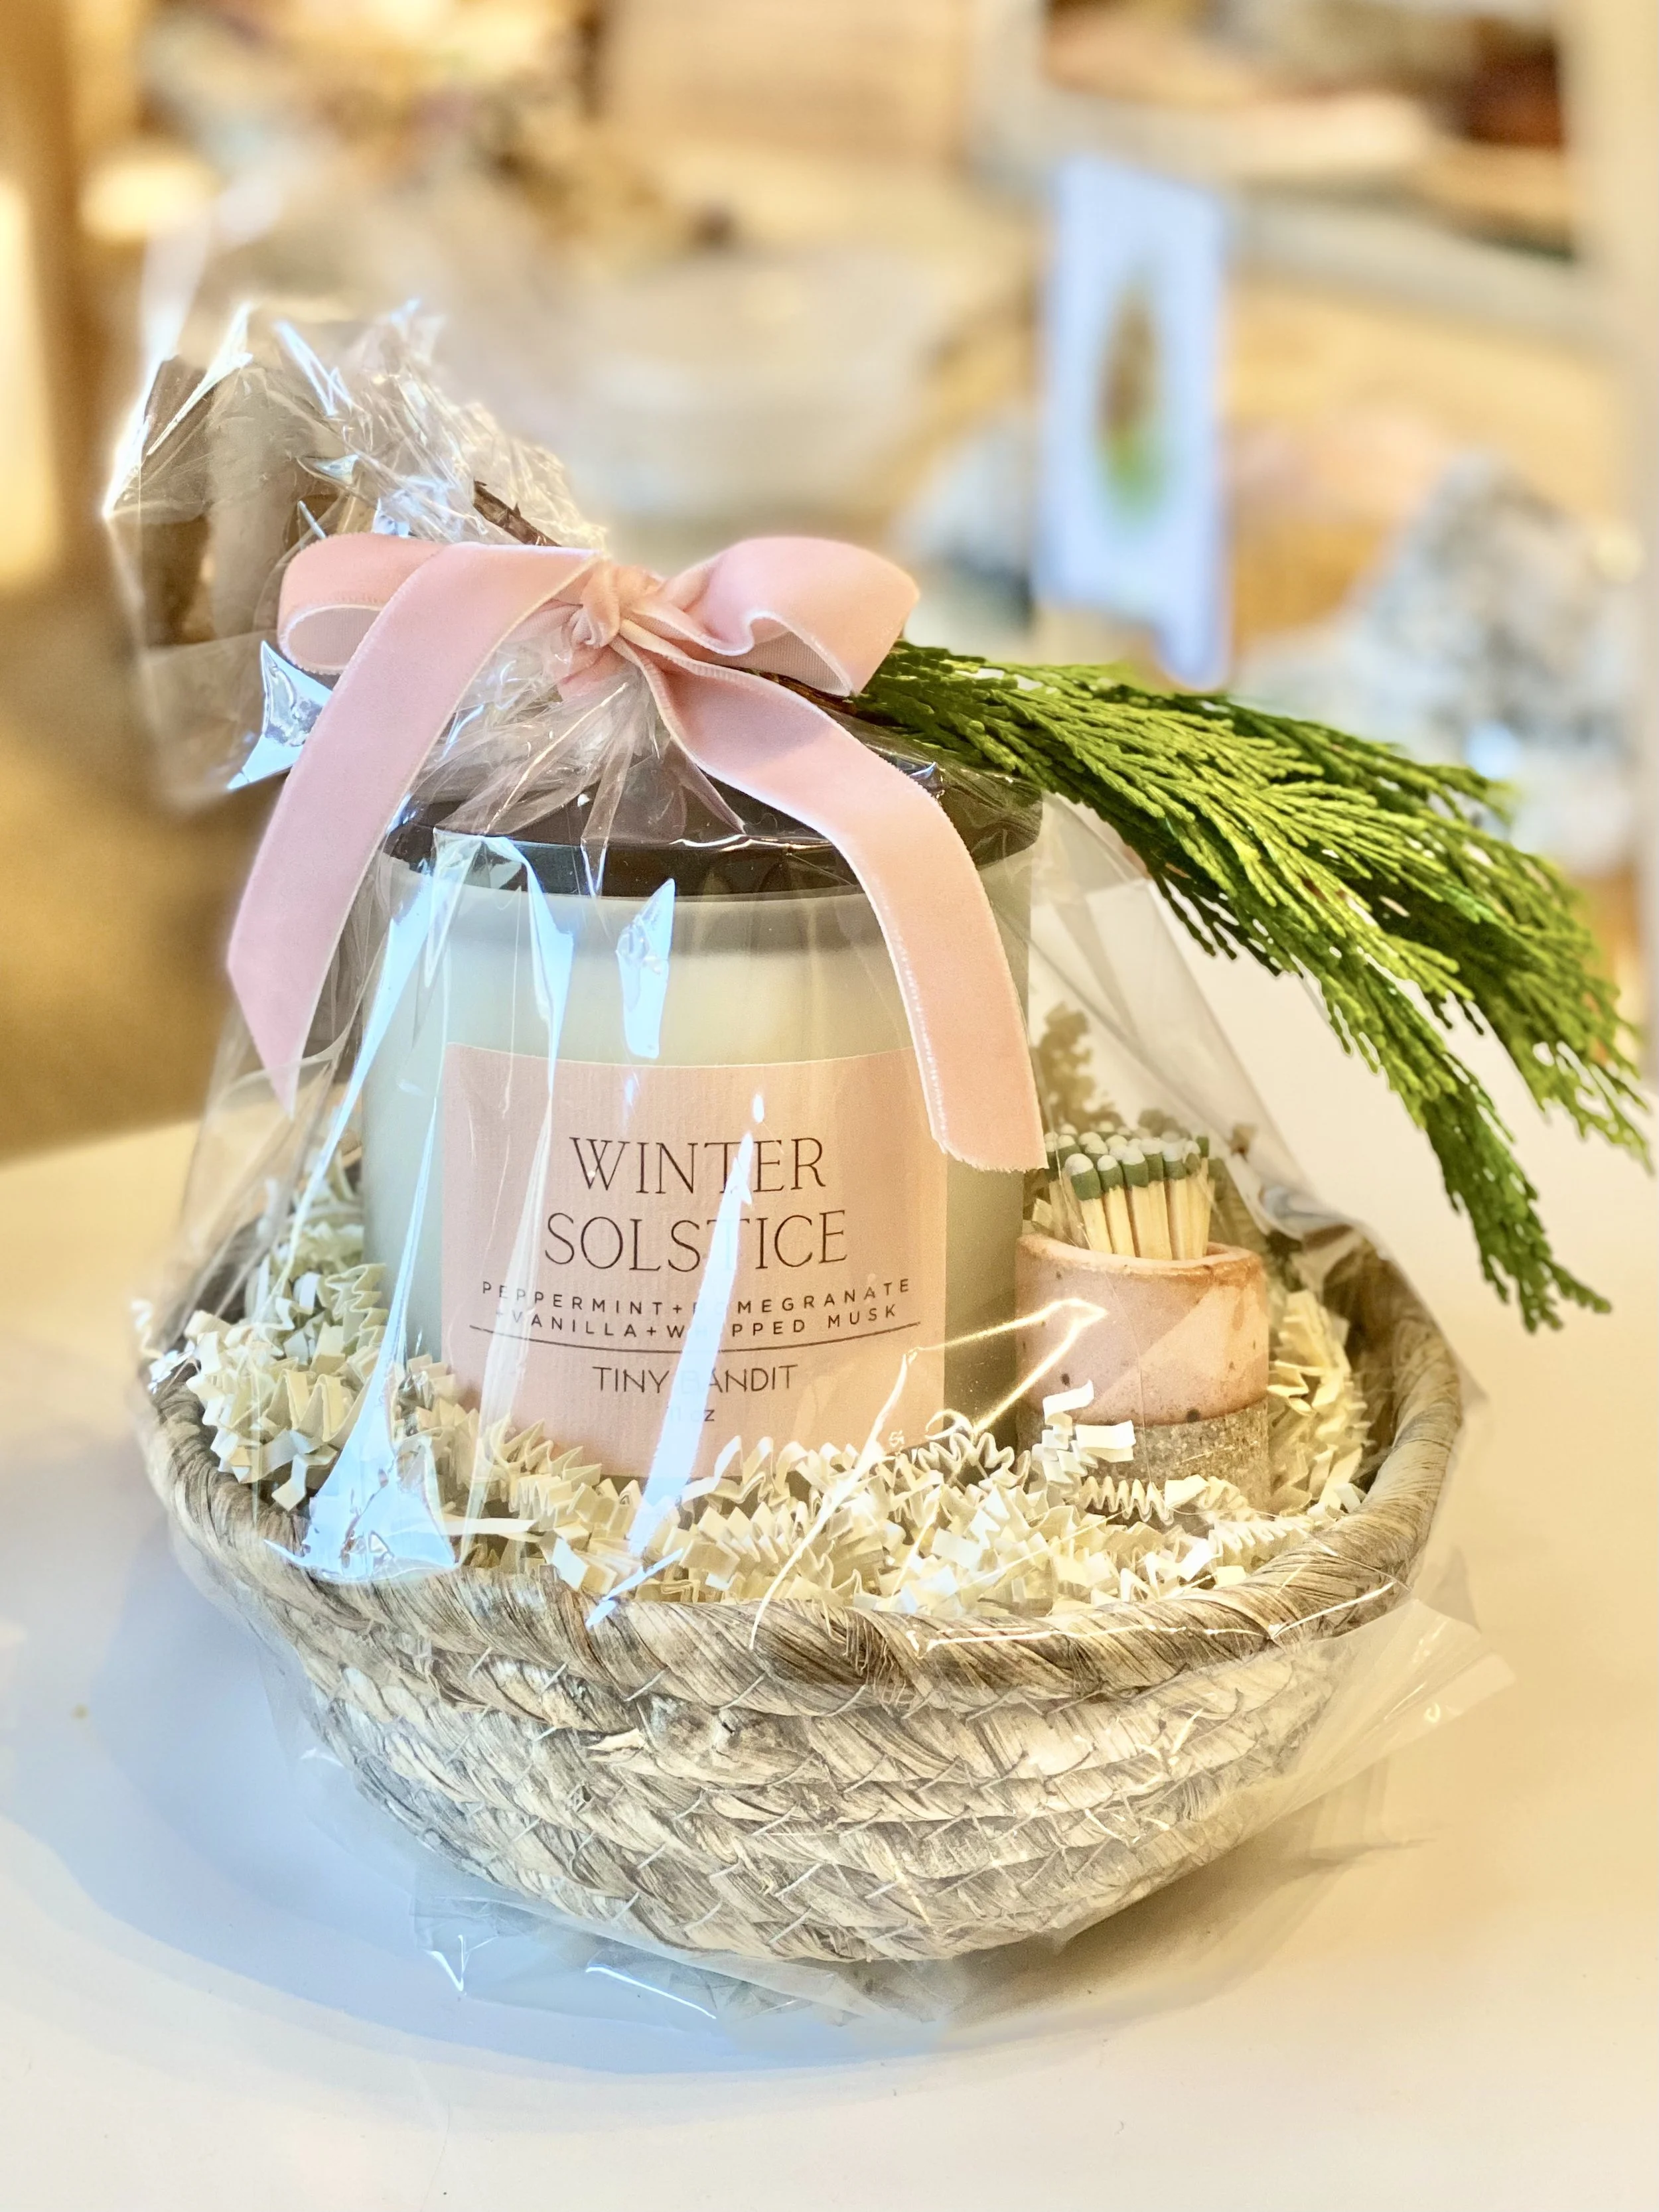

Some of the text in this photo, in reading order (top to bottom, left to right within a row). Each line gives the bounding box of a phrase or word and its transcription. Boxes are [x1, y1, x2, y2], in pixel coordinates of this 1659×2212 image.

[569, 1137, 826, 1194] WINTER
[545, 1210, 847, 1273] SOLSICE
[495, 1304, 896, 1339] +VANILLA+WPPED MUSK
[592, 1363, 798, 1394] TINY ANDIT
